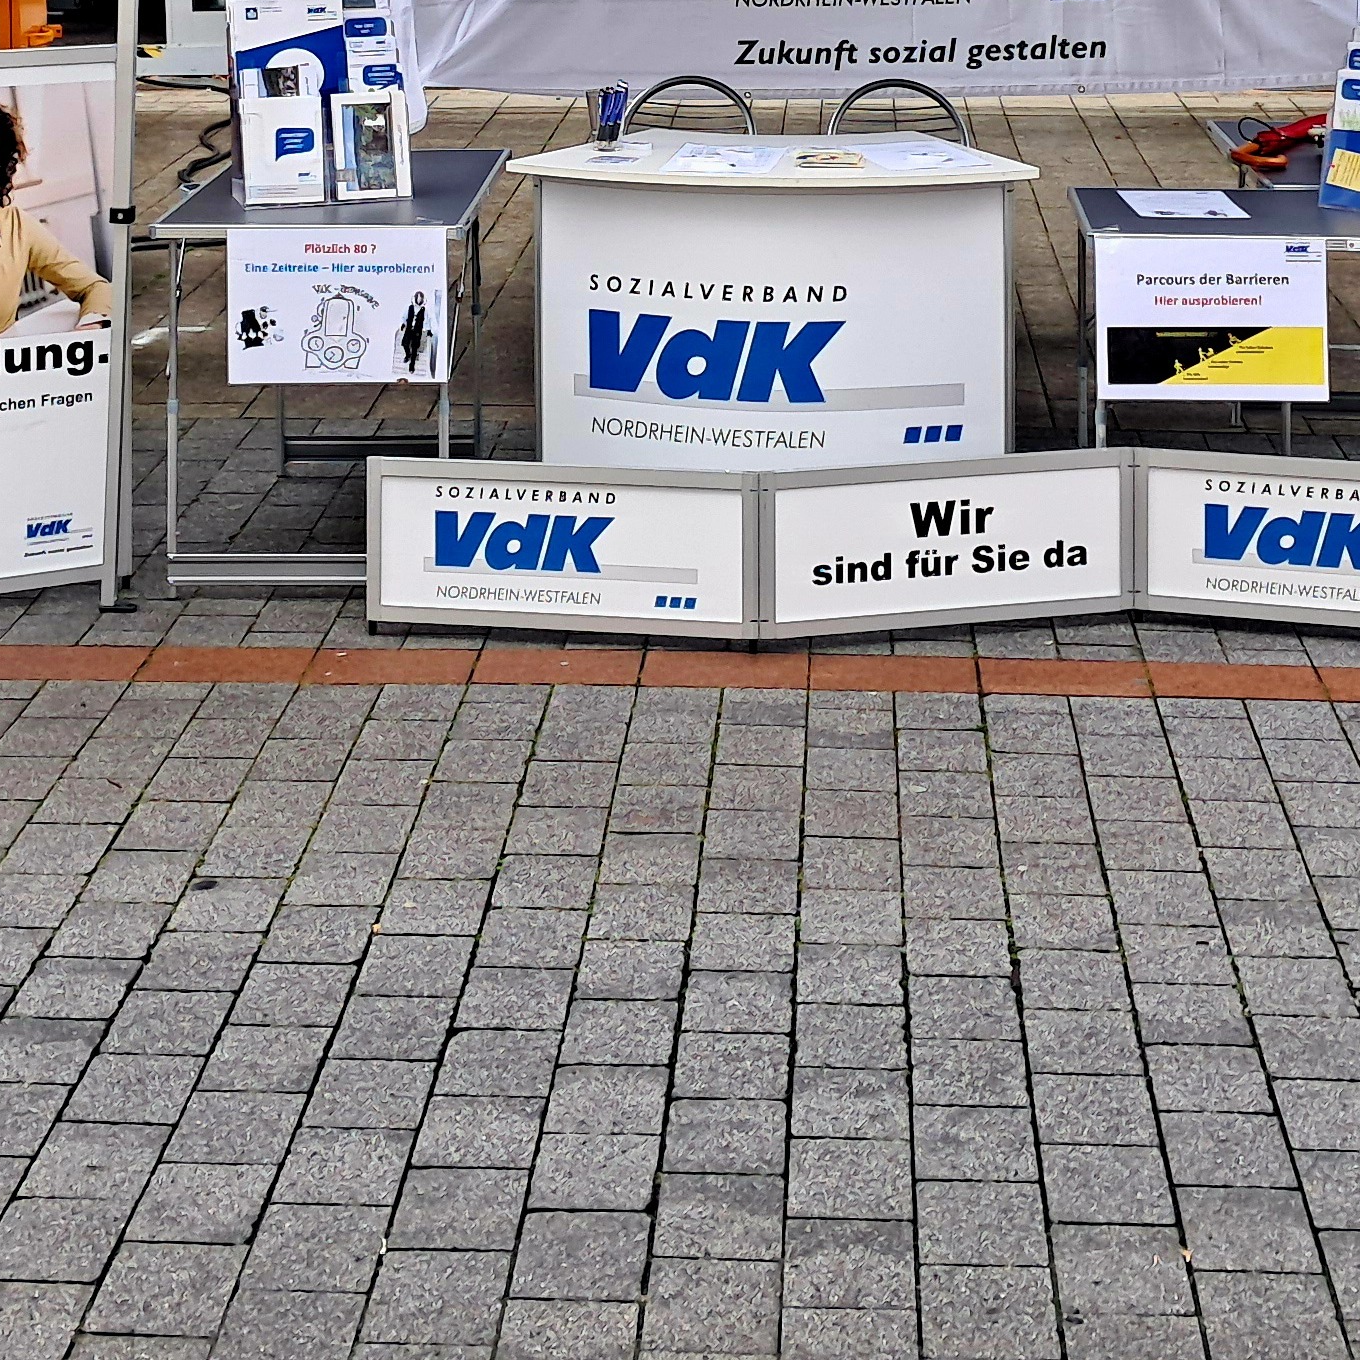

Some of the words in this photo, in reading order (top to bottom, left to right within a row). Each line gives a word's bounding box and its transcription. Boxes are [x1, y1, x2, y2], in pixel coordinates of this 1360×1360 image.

[734, 40, 858, 70] Zukunft
[869, 38, 957, 64] sozial
[966, 35, 1107, 69] gestalten
[305, 243, 350, 254] Plötzlich
[354, 244, 368, 254] 80
[245, 263, 268, 273] Eine
[272, 263, 319, 273] Zeitreise
[332, 263, 355, 273] Hier
[357, 263, 435, 275] ausprobieren!
[589, 274, 848, 303] SOZIALVERBAND
[1137, 274, 1195, 286] Parcours
[1200, 273, 1222, 286] der
[1226, 273, 1290, 286] Barrieren
[1155, 296, 1178, 306] Hier
[1182, 295, 1262, 308] ausprobieren!
[589, 308, 847, 403] VdK
[41, 392, 93, 407] Fragen
[591, 416, 826, 449] NORDRHEIN-WESTFALEN
[435, 486, 616, 504] SOZIALVERBAND
[26, 519, 72, 538] VdK
[910, 499, 994, 538] Wir
[435, 510, 615, 573] VdK
[812, 553, 891, 586] sind
[905, 550, 958, 578] für
[972, 544, 1029, 573] Sie
[1044, 540, 1087, 568] da
[436, 585, 601, 605] NORDRHEIN-WESTFALEN
